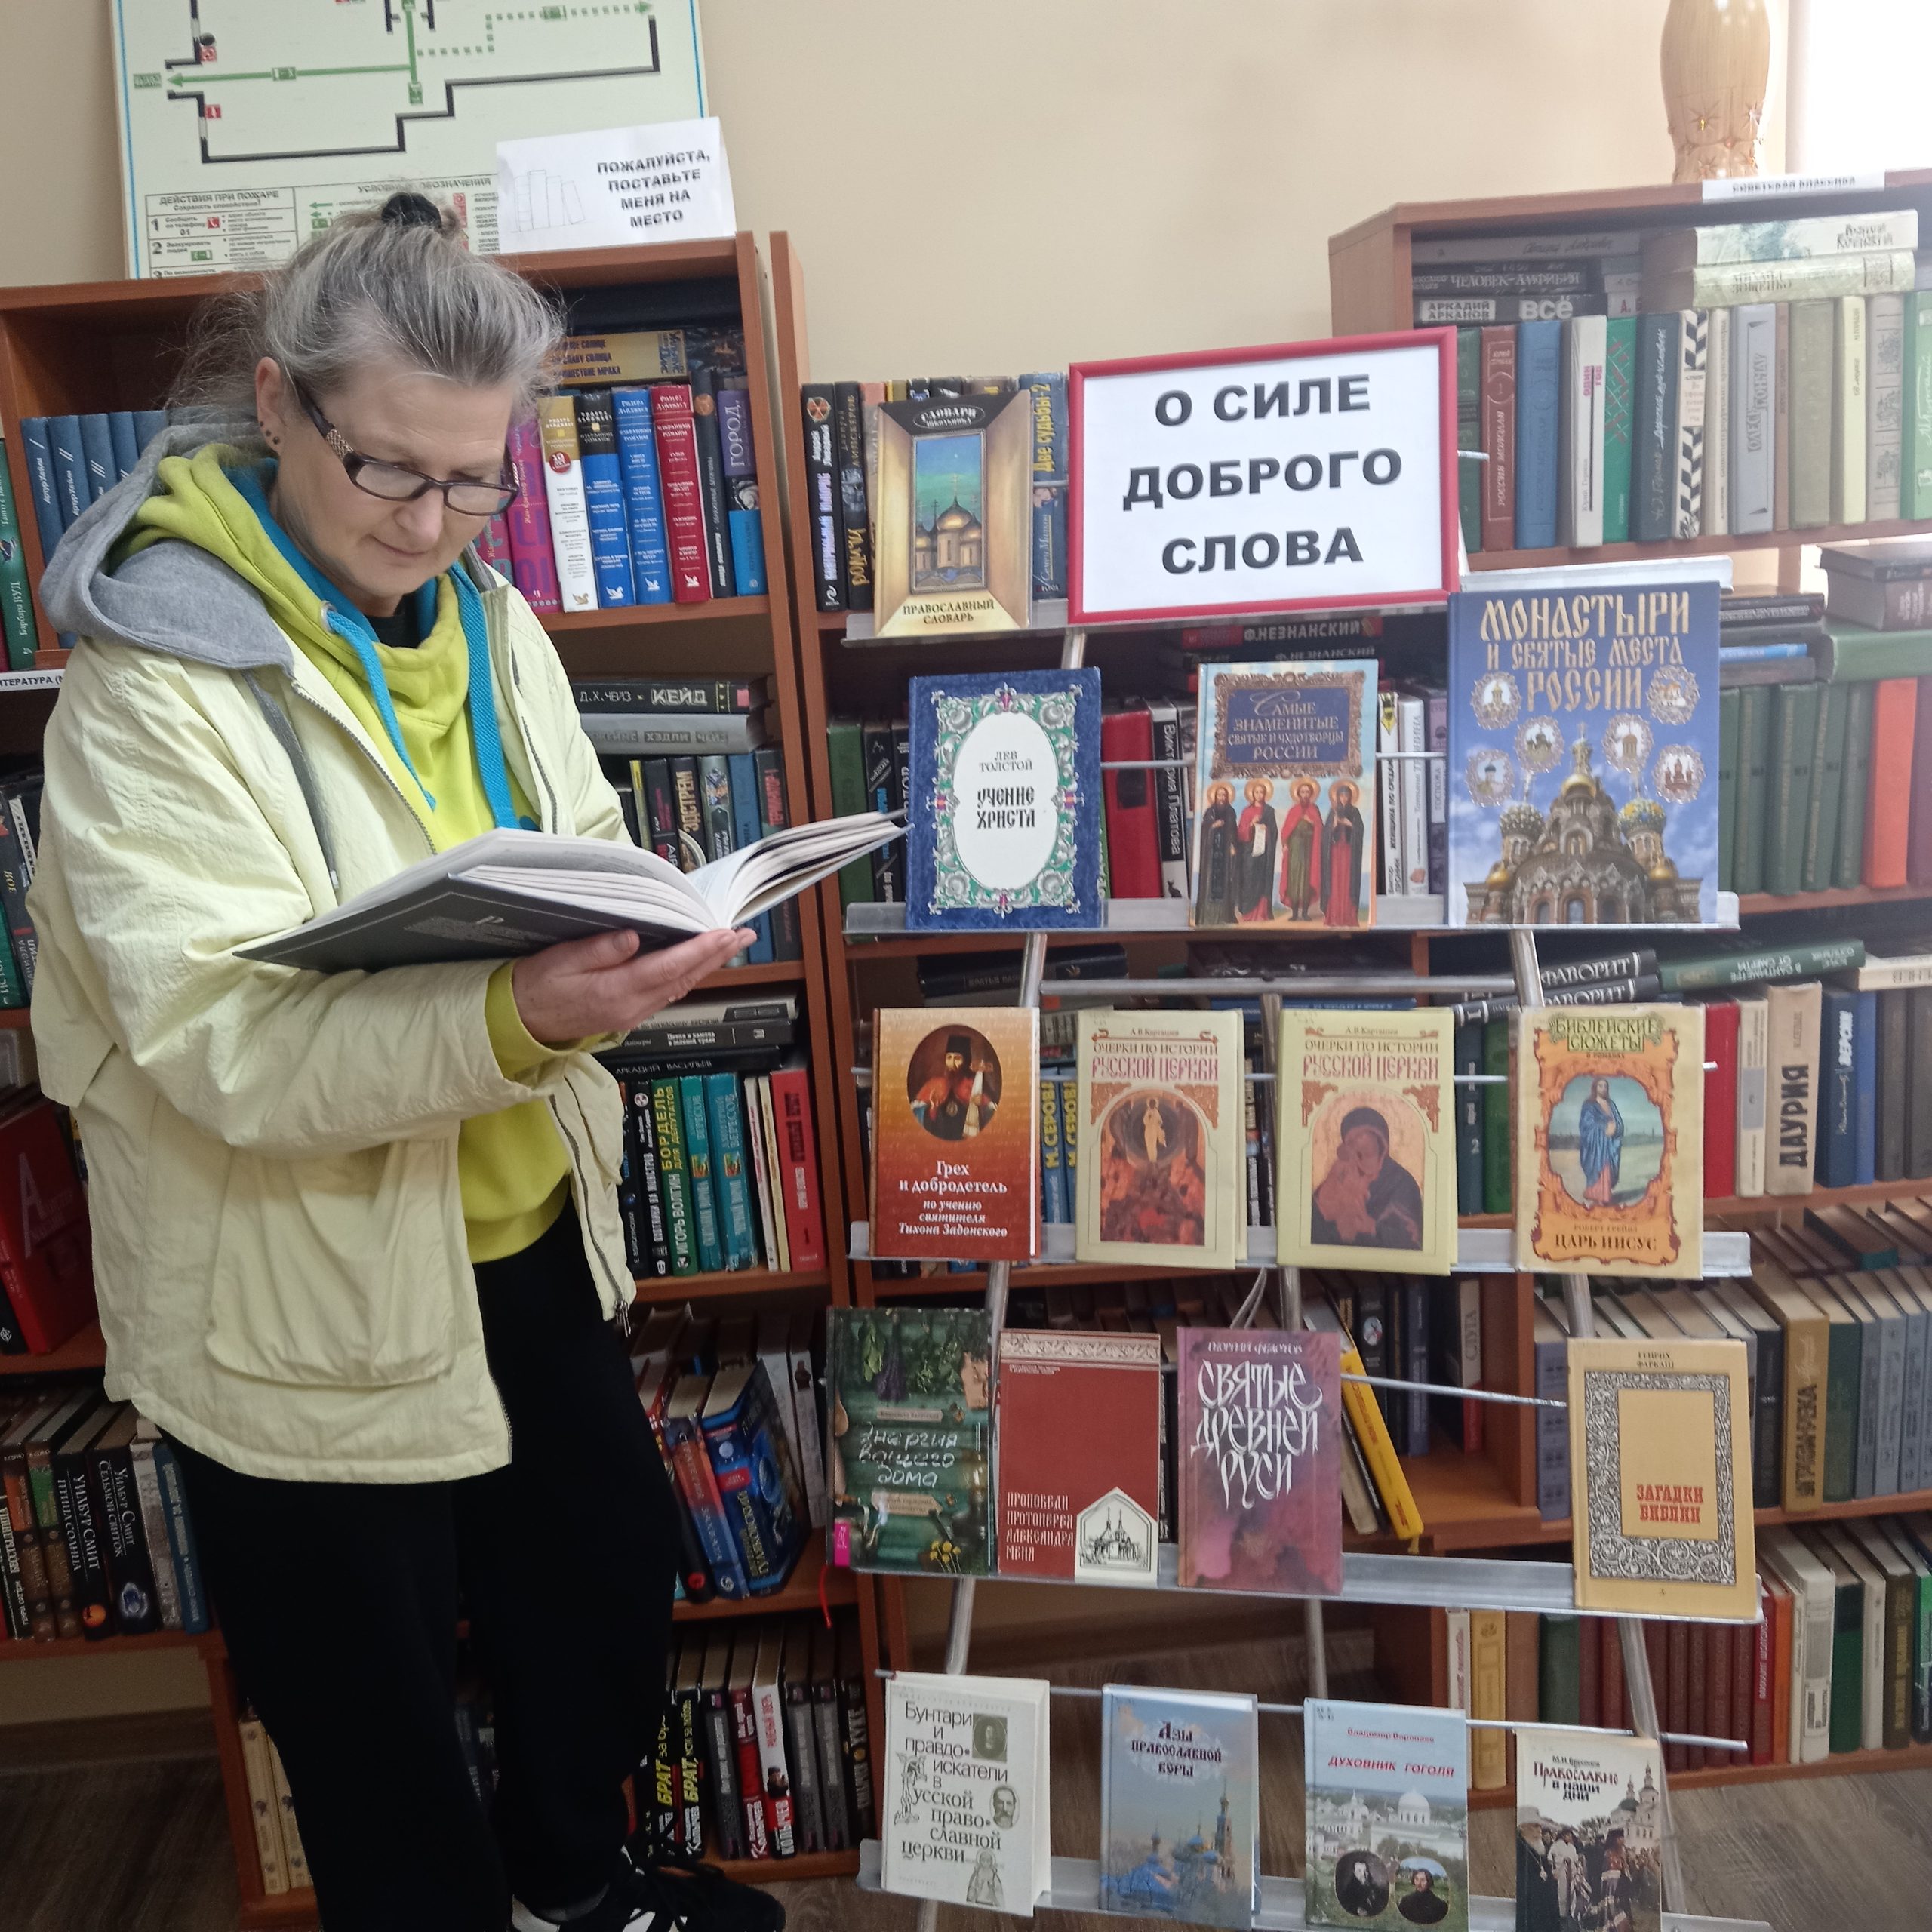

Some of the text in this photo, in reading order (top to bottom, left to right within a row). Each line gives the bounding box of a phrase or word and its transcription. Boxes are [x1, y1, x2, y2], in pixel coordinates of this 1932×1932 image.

[597, 150, 709, 174] ПОЖАЛУЙСТА,
[608, 169, 700, 192] ПОСТАВЬТЕ
[160, 191, 279, 206] ДЕЙСТВИЯ ПРИ ПОЖАРЕ
[621, 189, 691, 210] МЕНЯ НА
[630, 210, 683, 227] МЕСТО
[152, 242, 162, 254] 2
[1451, 272, 1580, 288] ЧЕЛОВЕК-АМФИБИЯ
[1427, 301, 1490, 311] АРКАДИЙ
[1428, 309, 1490, 320] АРКАНОВ
[1583, 365, 1592, 397] ОДИН
[1594, 365, 1603, 386] ГОД
[1755, 353, 1767, 410] ГОНЧАР
[1155, 374, 1371, 426] О СИЛЕ
[920, 405, 978, 422] СЛОВАРИ
[925, 417, 971, 428] ШКОЛЬНИКА
[1746, 409, 1762, 453] ОЛЕСЬ
[1032, 446, 1056, 472] Две
[1497, 411, 1506, 506] РОССИЯ МОЛОДАЯ
[1123, 448, 1402, 512] ДОБРОГО
[1161, 526, 1364, 575] СЛОВА
[11, 581, 29, 635] Барбара ВУД
[903, 598, 995, 616] ПРАВОСЛАВНЫЙ
[1479, 591, 1691, 642] МОНАСТЫРИ
[923, 612, 974, 625] СЛОВАРЬ
[1244, 620, 1360, 642] Ф.НЕЗНАНСКИЙ
[1487, 635, 1684, 670] И СВЯТЫЕ МЕСТА
[580, 685, 709, 706] Д.Х.ЧЕЙЗ КЕЙД
[1527, 666, 1642, 713] РОССИИ
[1232, 716, 1339, 733] ЗНАМЕНИТЫЕ
[1228, 731, 1344, 746] СВЯТЫЕ И ЧУДОТВОРЦЫ
[995, 751, 1018, 761] ЛЕВ
[1253, 746, 1318, 761] РОССИИ
[979, 758, 1033, 772] ТОЛСТОЙ
[977, 786, 1035, 810] УЧЕНИЕ
[1163, 724, 1183, 855] Виктрия Платова
[977, 809, 1035, 830] ХРИСТА
[4, 869, 17, 894] ЗОЯ
[1541, 958, 1630, 986] ФАВОРИТ
[1556, 1019, 1657, 1034] БИБЛЕЙСКИЕ
[1094, 1043, 1218, 1055] ОЧЕРКИ ПО ИСТОРИИ
[1305, 1040, 1438, 1054] ОЧЕРКИ ПО ИСТОРИИ
[1571, 1035, 1642, 1048] СЮЖЕТЫ
[615, 1060, 712, 1075] АРКАДИЙ ВАСИЛЬЕВ
[1092, 1055, 1218, 1083] РУССКОЙ ЦЕРКВИ
[1303, 1052, 1438, 1082] РУССКОЙ ЦЕРКВИ
[1778, 1065, 1808, 1168] ДАУРИЯ
[654, 1087, 672, 1170] БОРДЕЛЬ
[666, 1086, 683, 1170] ДЛЯ ДЕПУТАТОВ
[1470, 1138, 1480, 1155] 2
[936, 1160, 971, 1179] Грех
[900, 1179, 1008, 1195] и добродетель
[648, 1193, 660, 1203] НА
[923, 1200, 982, 1213] по учению
[648, 1204, 663, 1242] ОХОТНИКИ
[668, 1174, 688, 1254] ИГОРЬ ВОЛГИН
[919, 1211, 986, 1224] святителя
[899, 1222, 1008, 1238] Тихона Задонского
[1555, 1234, 1657, 1251] ЦАРЬ ИИСУС
[1465, 1309, 1479, 1361] СЛУГА
[1197, 1359, 1323, 1412] СВЯТЫЕ
[1190, 1404, 1319, 1468] ДРЕВНЕЙ
[1220, 1448, 1293, 1510] РУСИ
[1007, 1491, 1069, 1511] ПРОПОВЕДИ
[1636, 1484, 1703, 1503] ЗАГАДКИ
[73, 1474, 100, 1570] УИЛБУР СМИТ
[1007, 1510, 1074, 1529] ПРОТОИЕРЕЯ
[1639, 1504, 1701, 1524] БИБЛИИ
[57, 1479, 82, 1571] ПТИЦА СОЛНЦА
[1006, 1527, 1074, 1547] АЛЕКСАНДРА
[1006, 1546, 1035, 1562] МЕНЯ
[906, 1701, 972, 1729] Бунтари
[934, 1727, 943, 1739] и
[1158, 1721, 1193, 1743] Азы
[1348, 1727, 1392, 1739] Владимир
[1131, 1740, 1223, 1764] православной
[933, 1759, 1008, 1783] искатели
[1158, 1763, 1195, 1777] веры
[1328, 1755, 1454, 1777] ДУХОВНИК ГОГОЛЯ
[933, 1776, 942, 1788] в
[776, 1800, 795, 1855] КОЛЫЧЕВ
[930, 1826, 1001, 1850] славной
[902, 1840, 964, 1863] церкви
